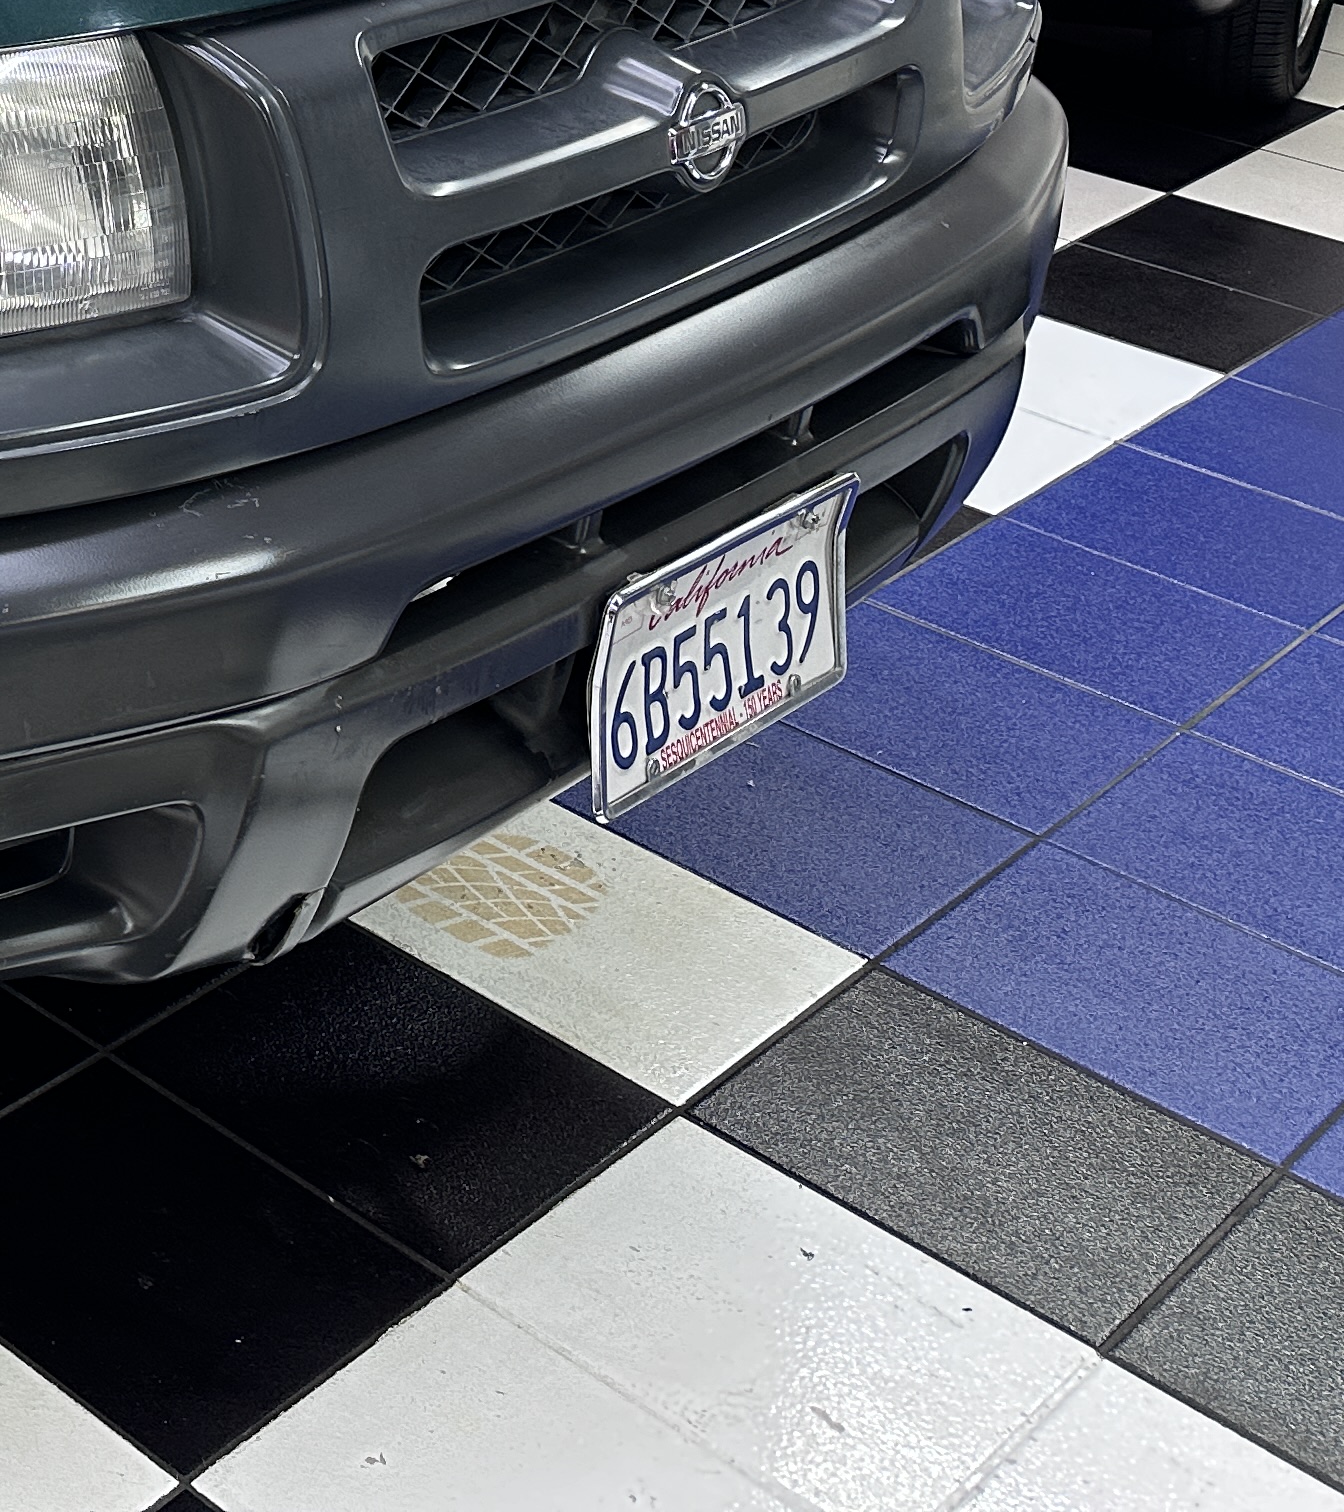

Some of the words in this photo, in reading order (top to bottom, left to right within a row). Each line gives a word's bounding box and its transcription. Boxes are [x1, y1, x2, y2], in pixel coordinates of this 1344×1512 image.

[681, 109, 741, 155] NISSAN
[612, 560, 820, 770] 6B55139
[660, 706, 739, 769] SESQUICENTENNIAL
[743, 694, 758, 721] 150
[757, 682, 783, 712] YEARS
